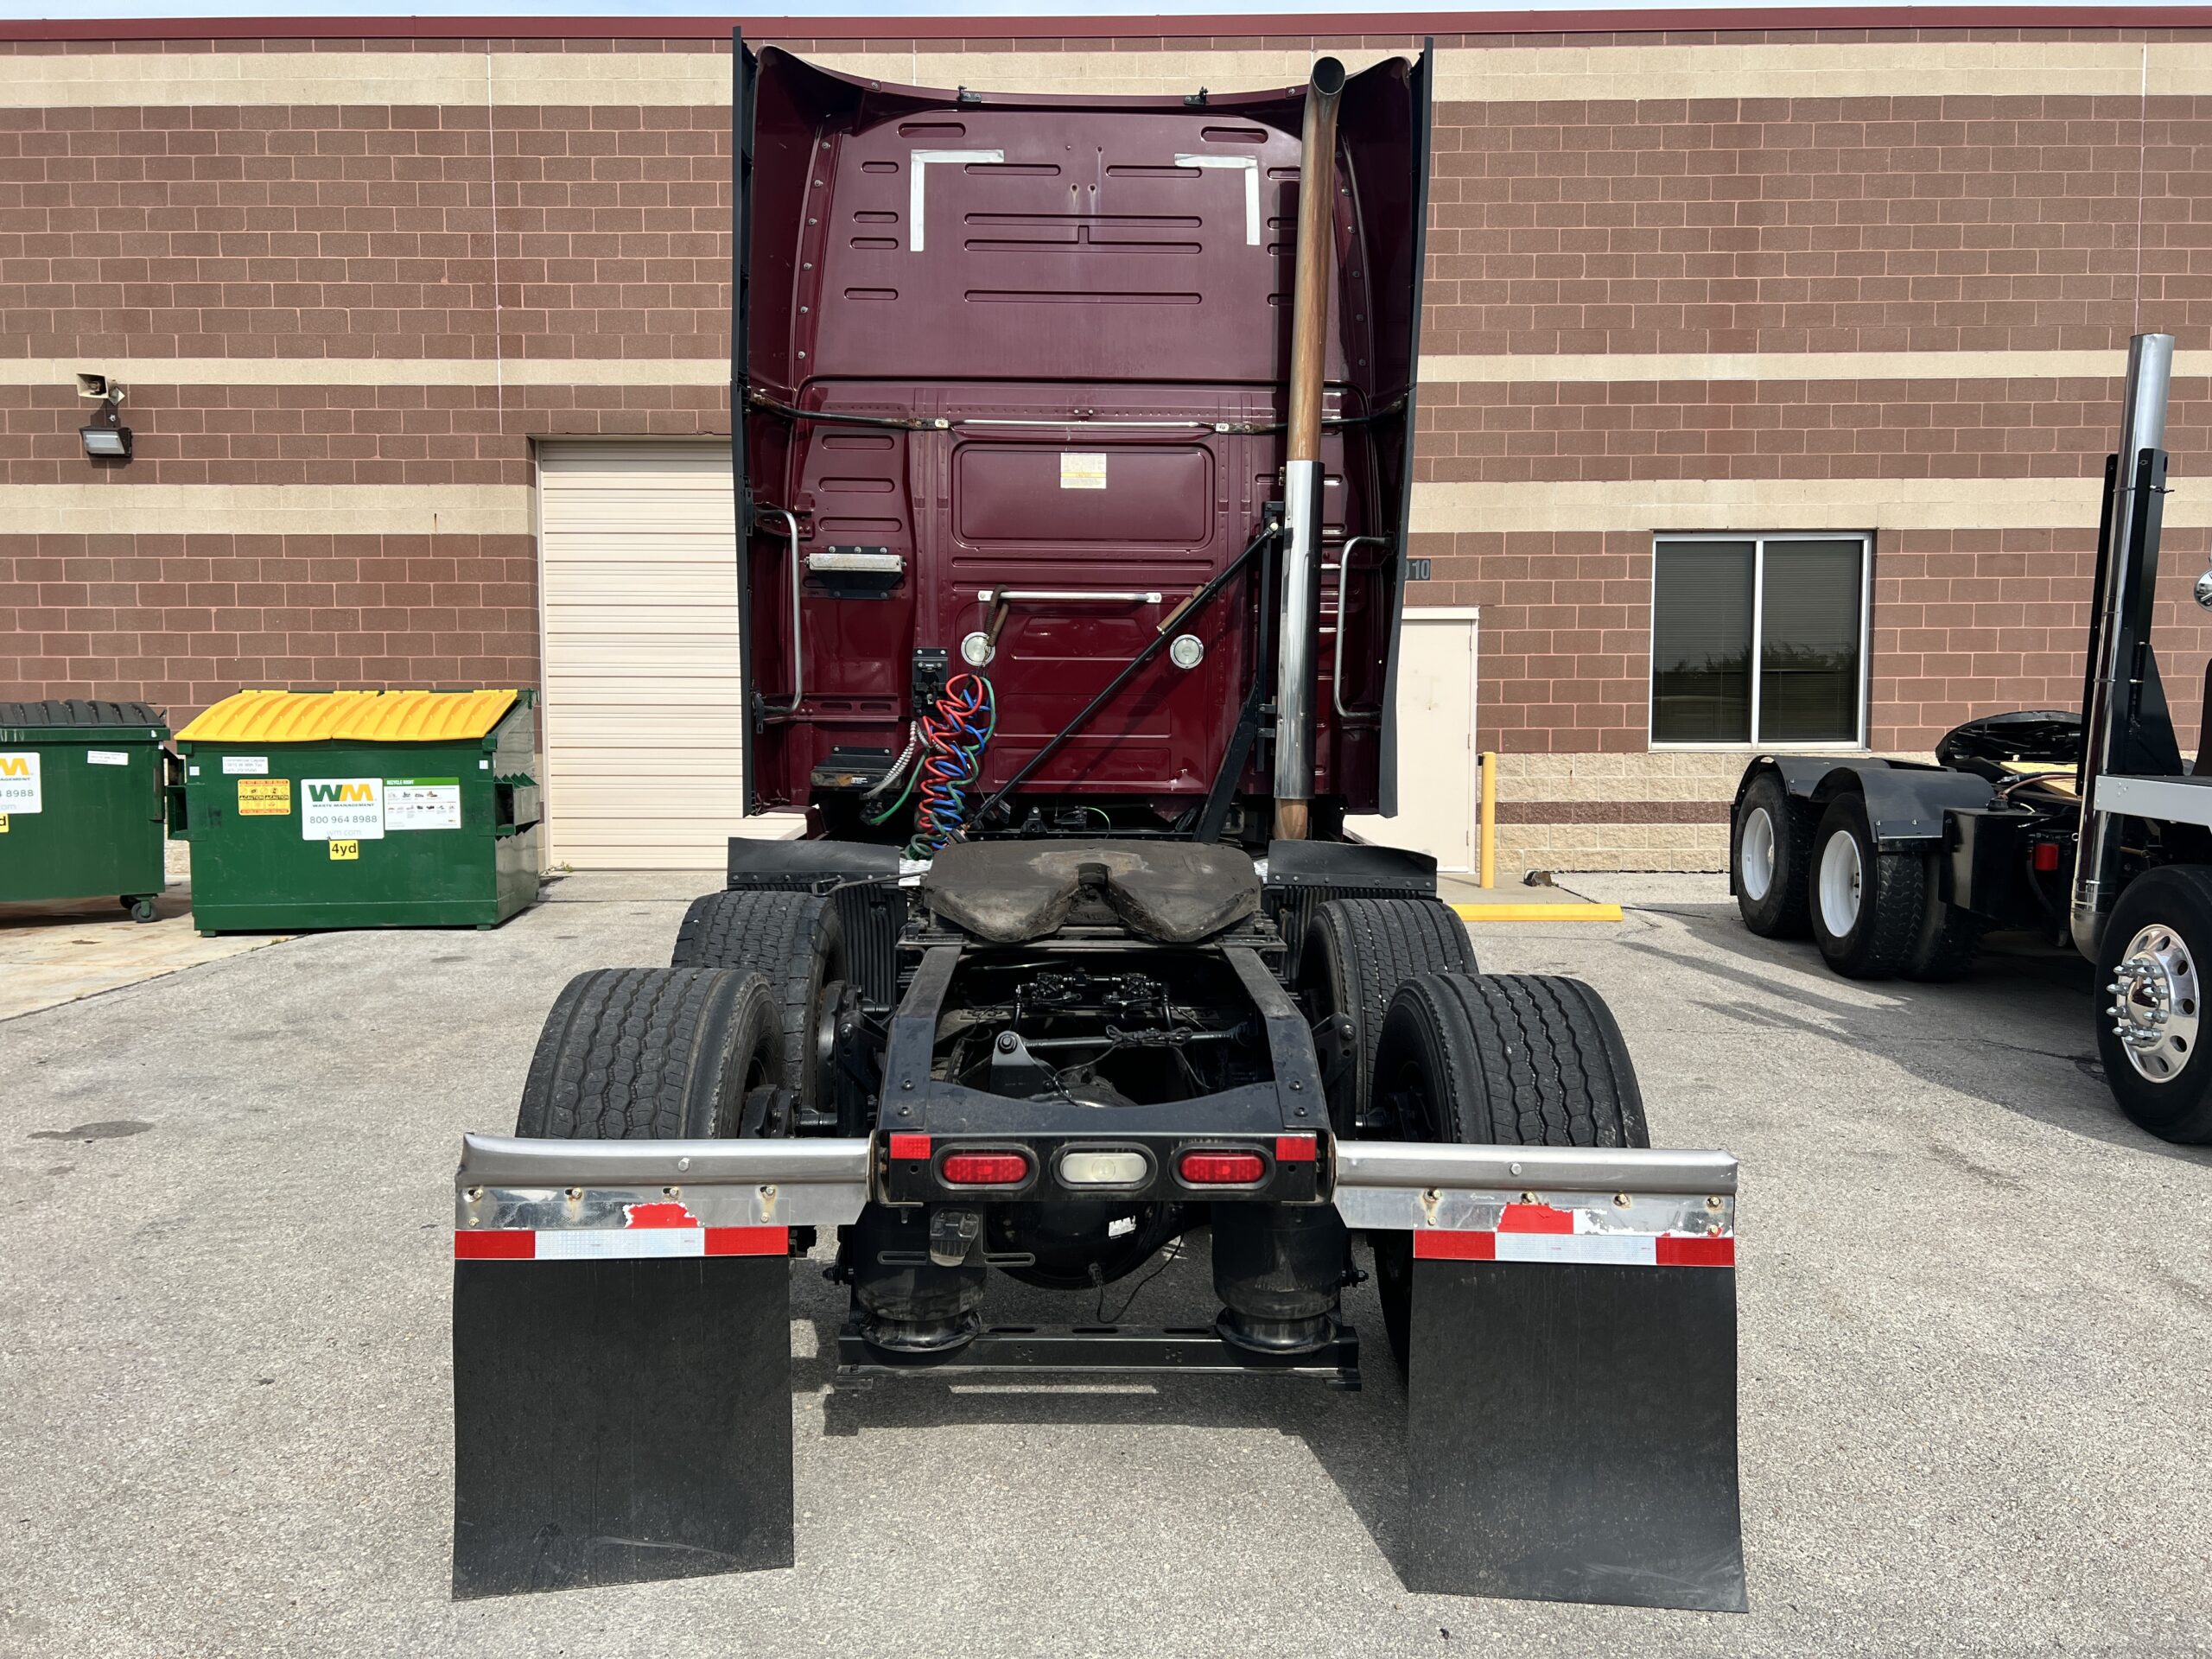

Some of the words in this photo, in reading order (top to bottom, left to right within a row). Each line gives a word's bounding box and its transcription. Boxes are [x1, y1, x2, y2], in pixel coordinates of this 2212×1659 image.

[0, 758, 29, 776] M
[6, 789, 34, 798] 8988
[308, 784, 374, 802] WM
[331, 843, 357, 856] 4yd
